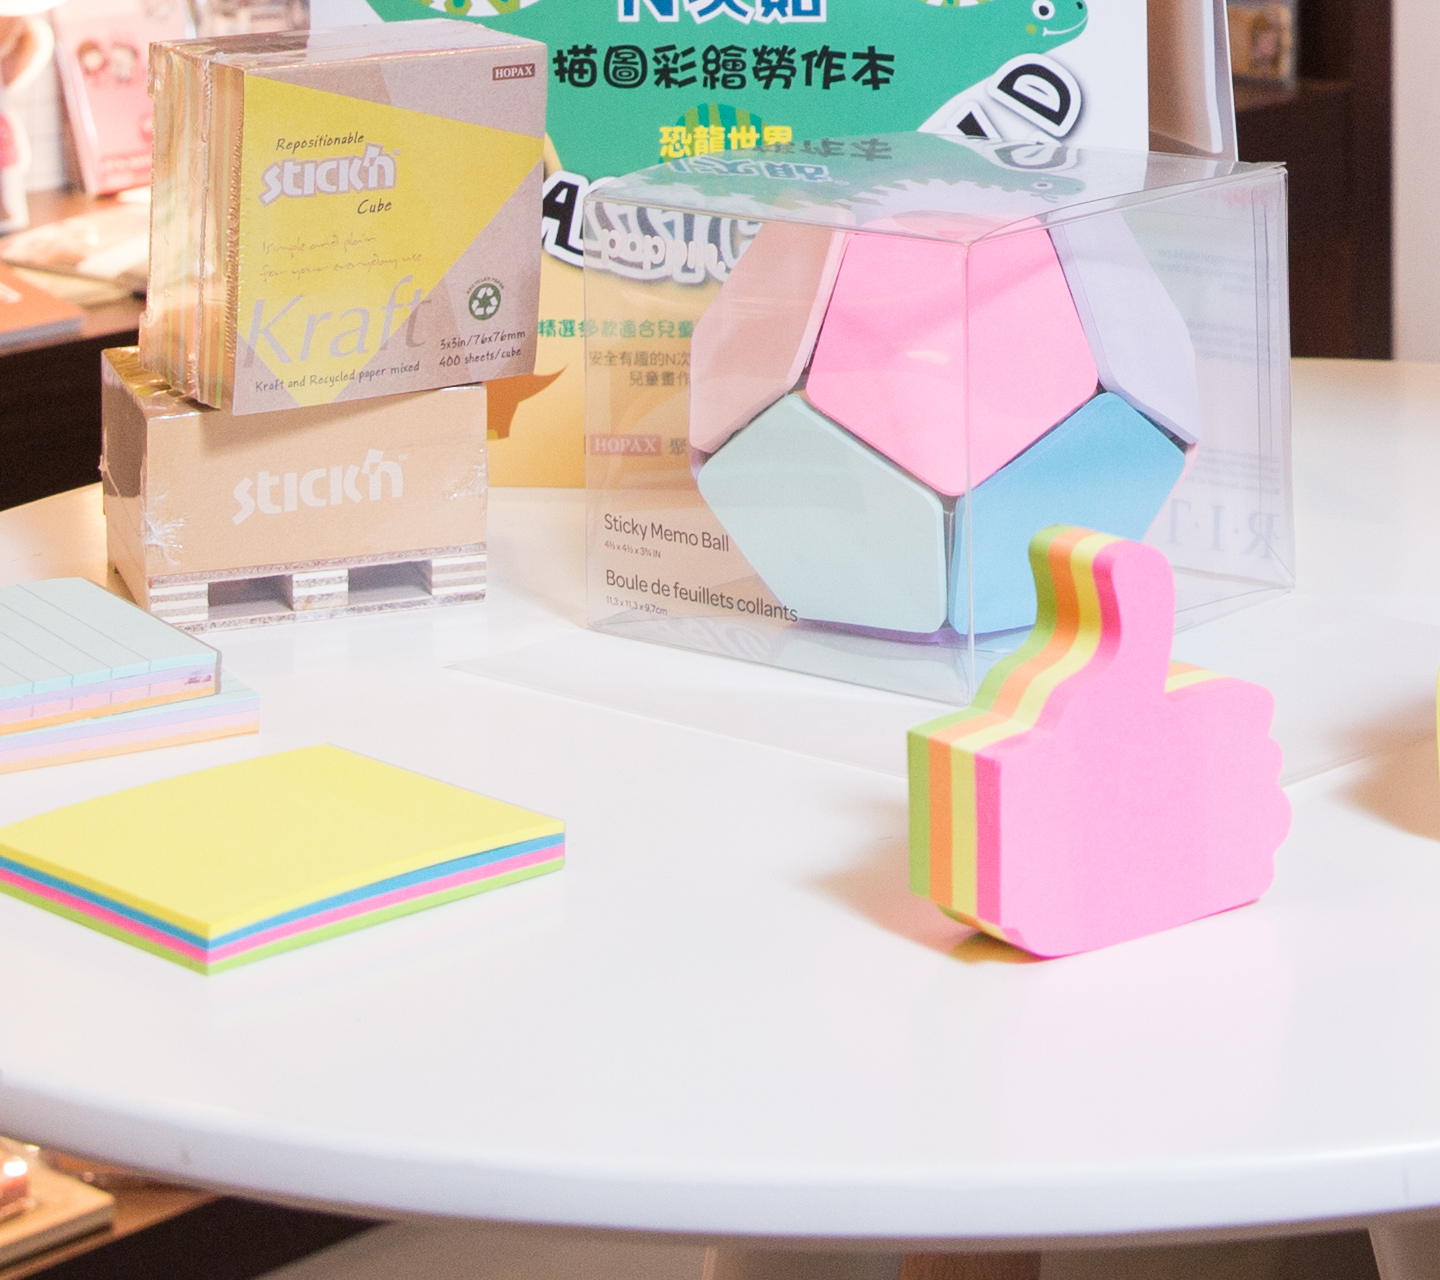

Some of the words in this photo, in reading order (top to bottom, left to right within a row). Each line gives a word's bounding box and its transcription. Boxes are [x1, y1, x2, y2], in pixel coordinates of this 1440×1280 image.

[494, 65, 535, 80] HOPAX
[552, 45, 897, 93] 描圖彩繪勞作本
[276, 131, 365, 153] Repositionable
[659, 124, 793, 158] 恐龍世界
[357, 199, 393, 214] Cube
[243, 274, 432, 368] Kraft
[439, 355, 461, 367] 400
[464, 346, 522, 365] sheets/cube
[255, 380, 285, 392] Kraft
[287, 376, 306, 388] and
[310, 369, 356, 386] Recycled
[358, 368, 386, 382] paper
[390, 360, 421, 374] mixed
[594, 437, 658, 453] HOPAX
[604, 512, 648, 542] Sticky
[650, 522, 699, 547] Memo
[701, 531, 730, 552] Ball
[606, 569, 648, 594] Boule
[651, 578, 671, 597] de
[673, 581, 734, 610] feuillets
[737, 597, 798, 622] collants
